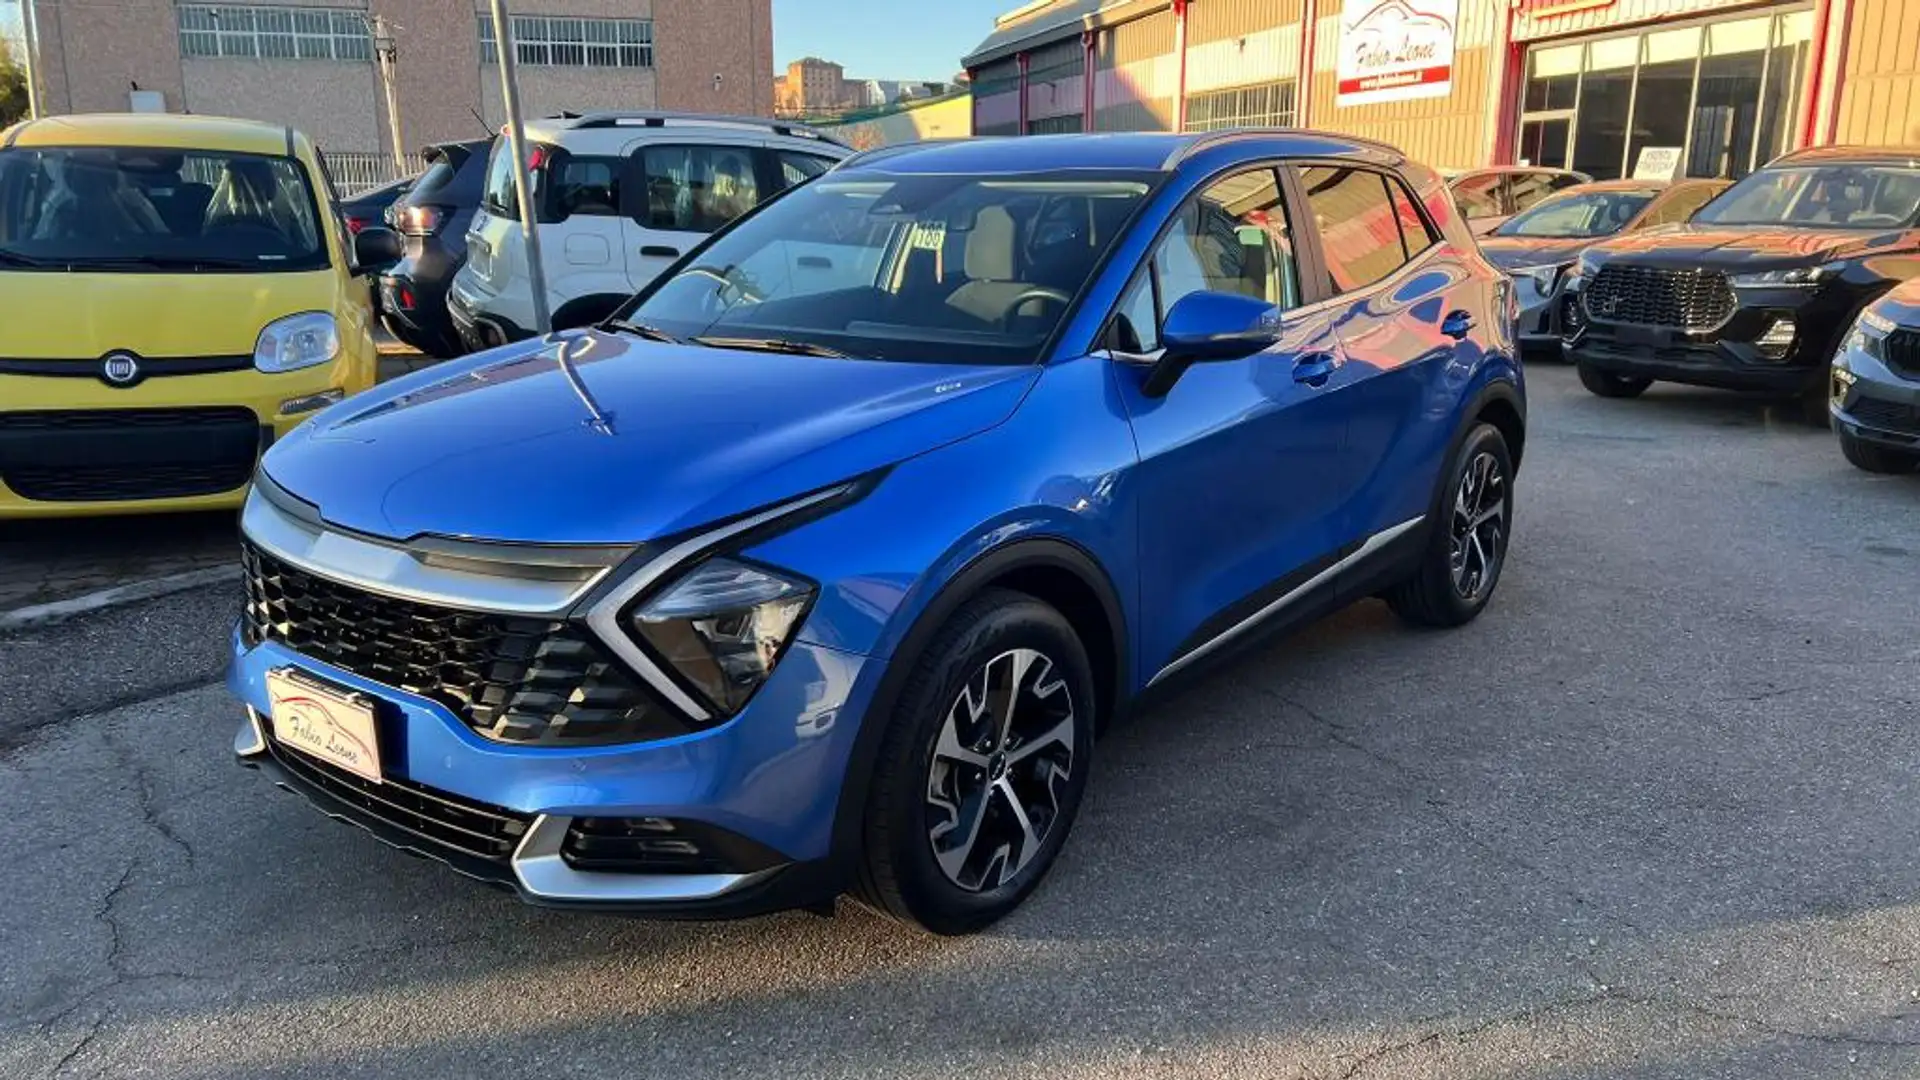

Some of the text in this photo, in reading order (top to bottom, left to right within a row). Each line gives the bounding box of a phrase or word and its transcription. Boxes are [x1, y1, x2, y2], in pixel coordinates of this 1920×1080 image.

[1355, 33, 1435, 71] Fabio Leone
[289, 716, 322, 746] Fabio
